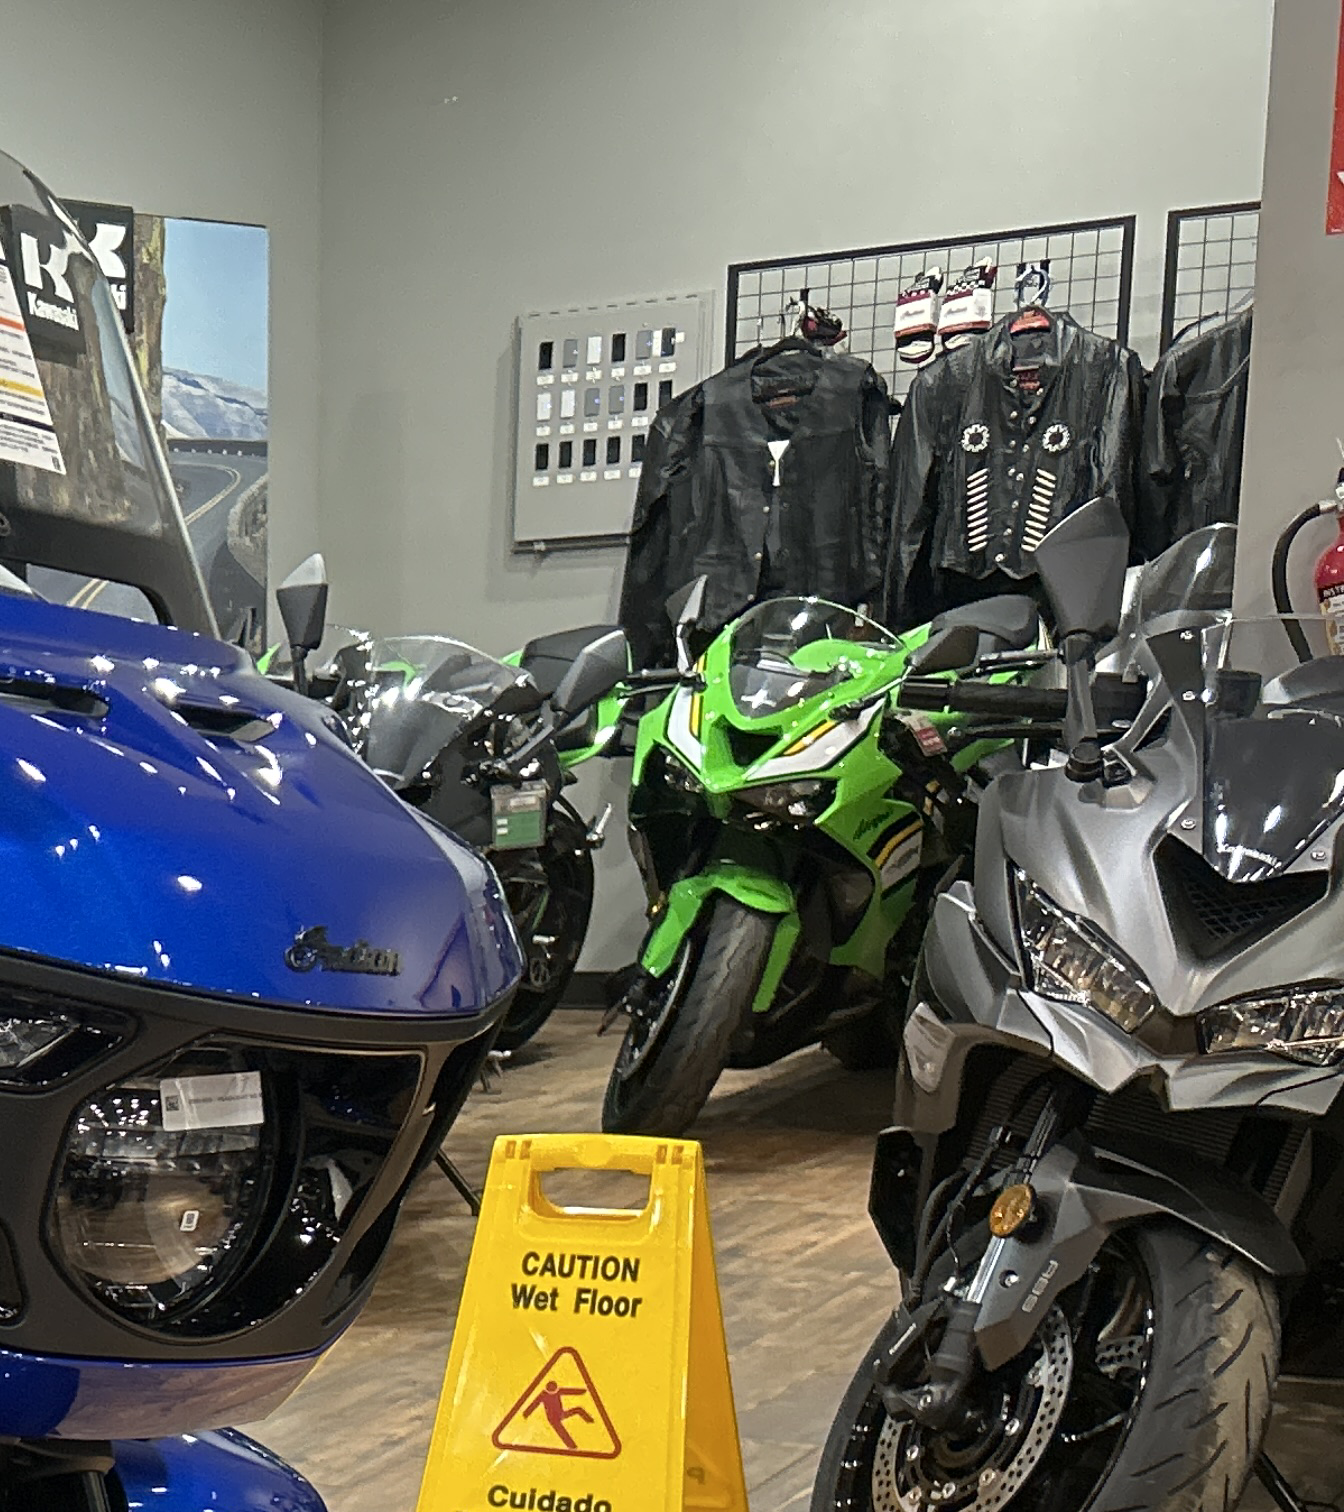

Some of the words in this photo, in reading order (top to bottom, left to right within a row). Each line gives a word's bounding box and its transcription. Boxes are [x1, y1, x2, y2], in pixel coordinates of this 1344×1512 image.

[521, 1251, 641, 1283] CAUTION
[511, 1283, 560, 1312] Wet
[573, 1287, 644, 1318] Floor
